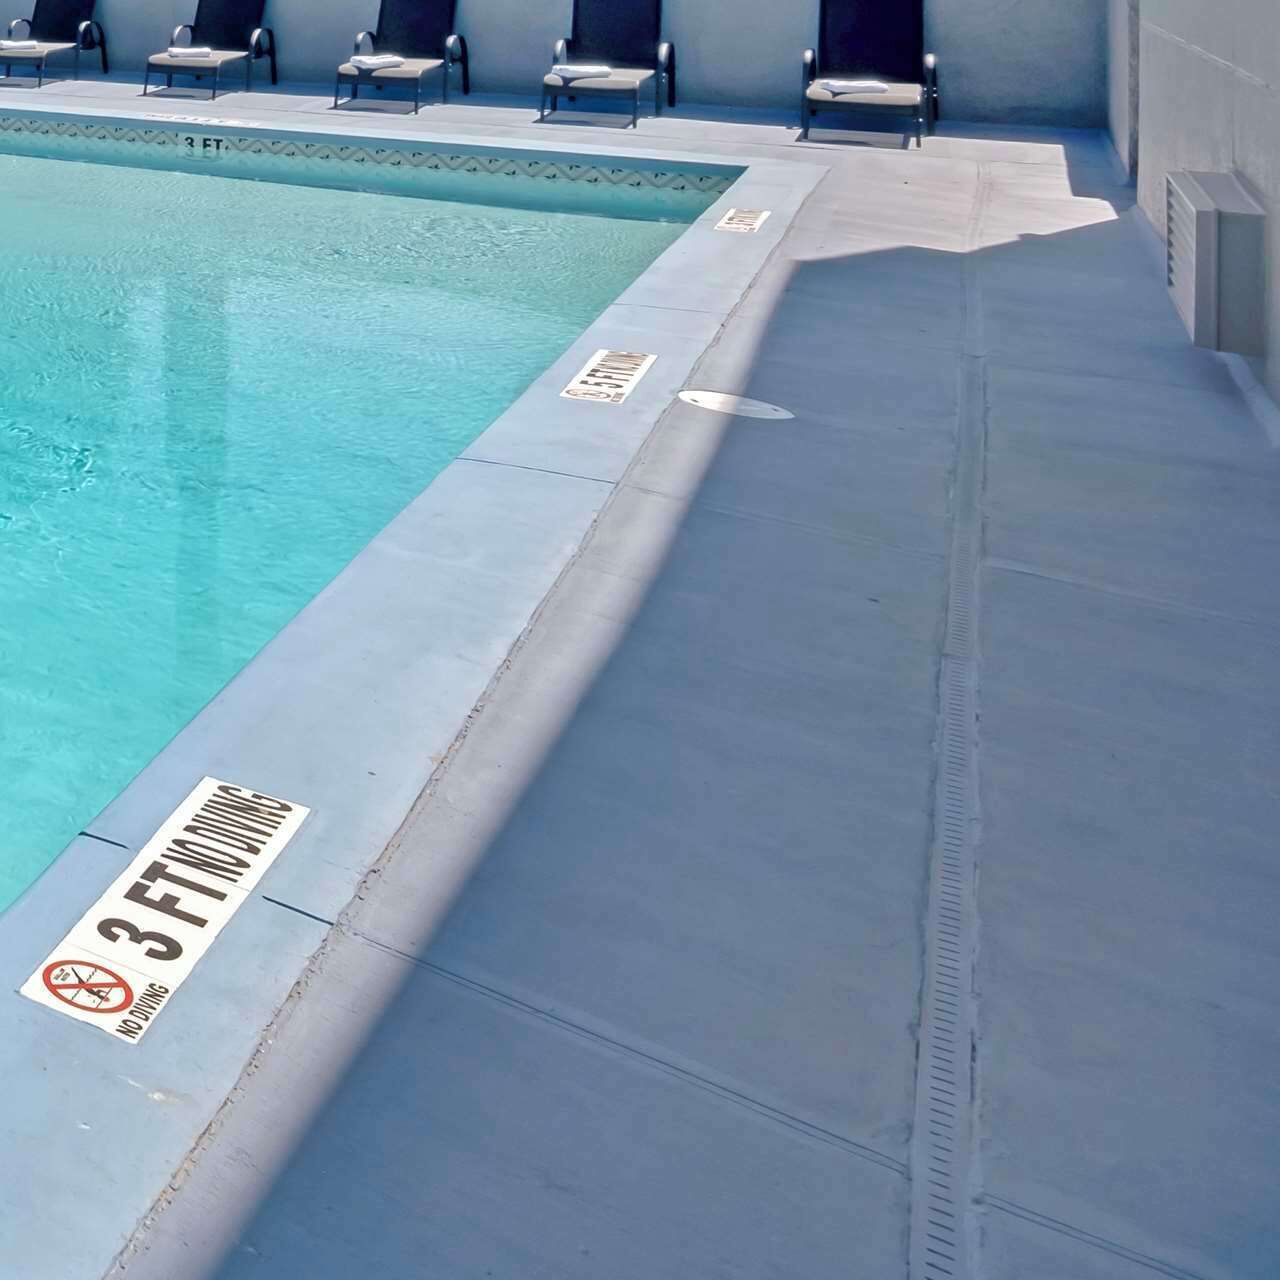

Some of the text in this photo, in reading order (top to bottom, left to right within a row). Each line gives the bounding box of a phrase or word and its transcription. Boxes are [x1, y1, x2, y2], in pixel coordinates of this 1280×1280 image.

[96, 784, 293, 962] 3 FT NO DIVING
[115, 982, 170, 1040] NO DIVING
